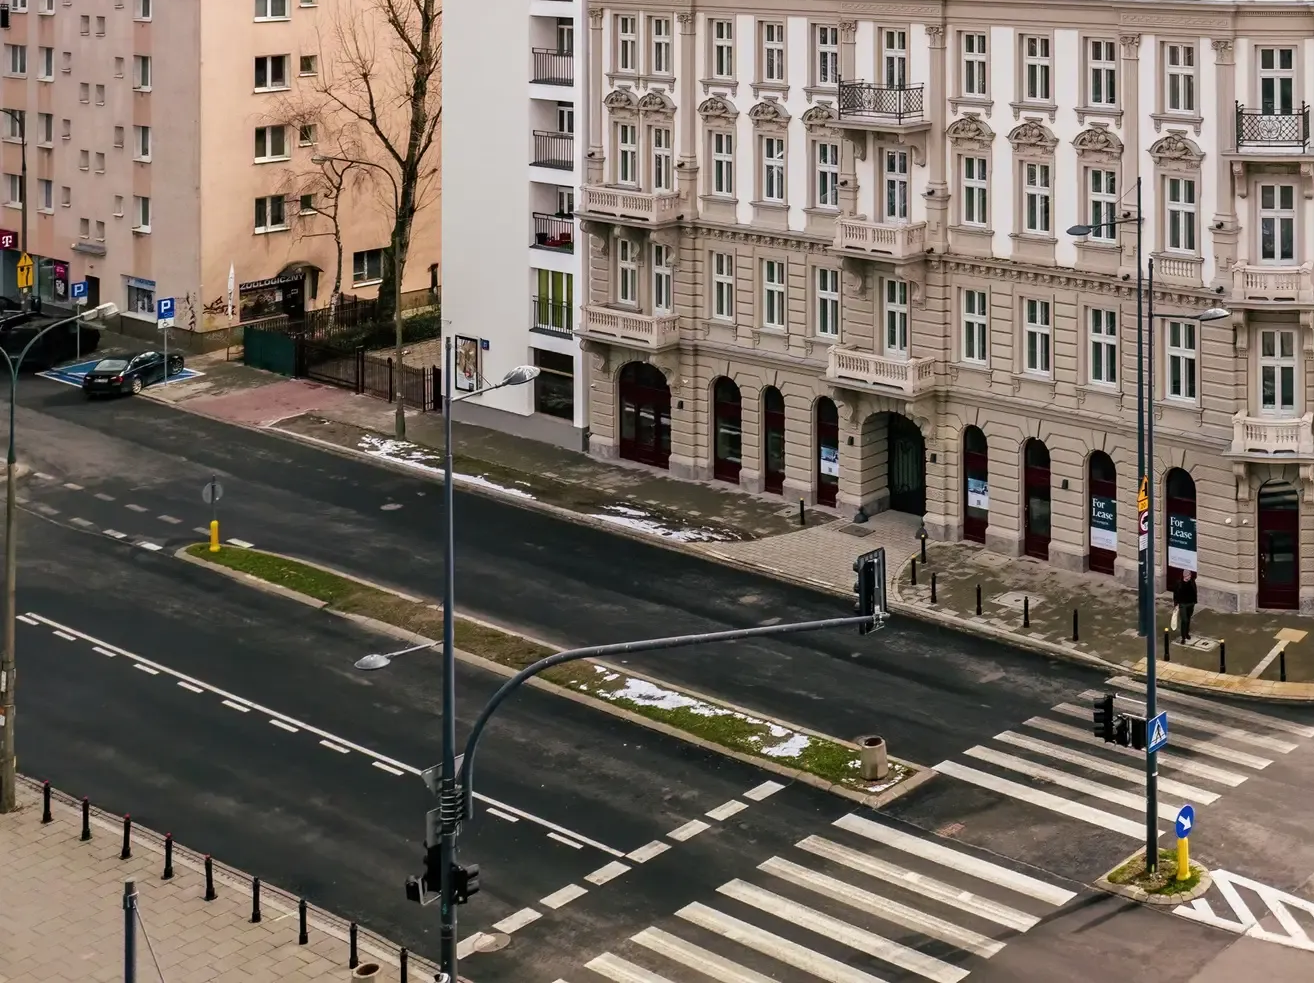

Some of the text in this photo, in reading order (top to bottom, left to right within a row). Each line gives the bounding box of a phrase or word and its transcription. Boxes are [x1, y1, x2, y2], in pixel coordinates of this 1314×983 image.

[2, 235, 12, 247] T
[239, 273, 305, 290] ZOOLOGICZNY
[74, 284, 84, 297] P
[161, 300, 171, 313] P
[1092, 497, 1106, 509] For
[1092, 508, 1113, 521] Lease
[1170, 516, 1184, 528] For
[1170, 527, 1193, 540] Lease
